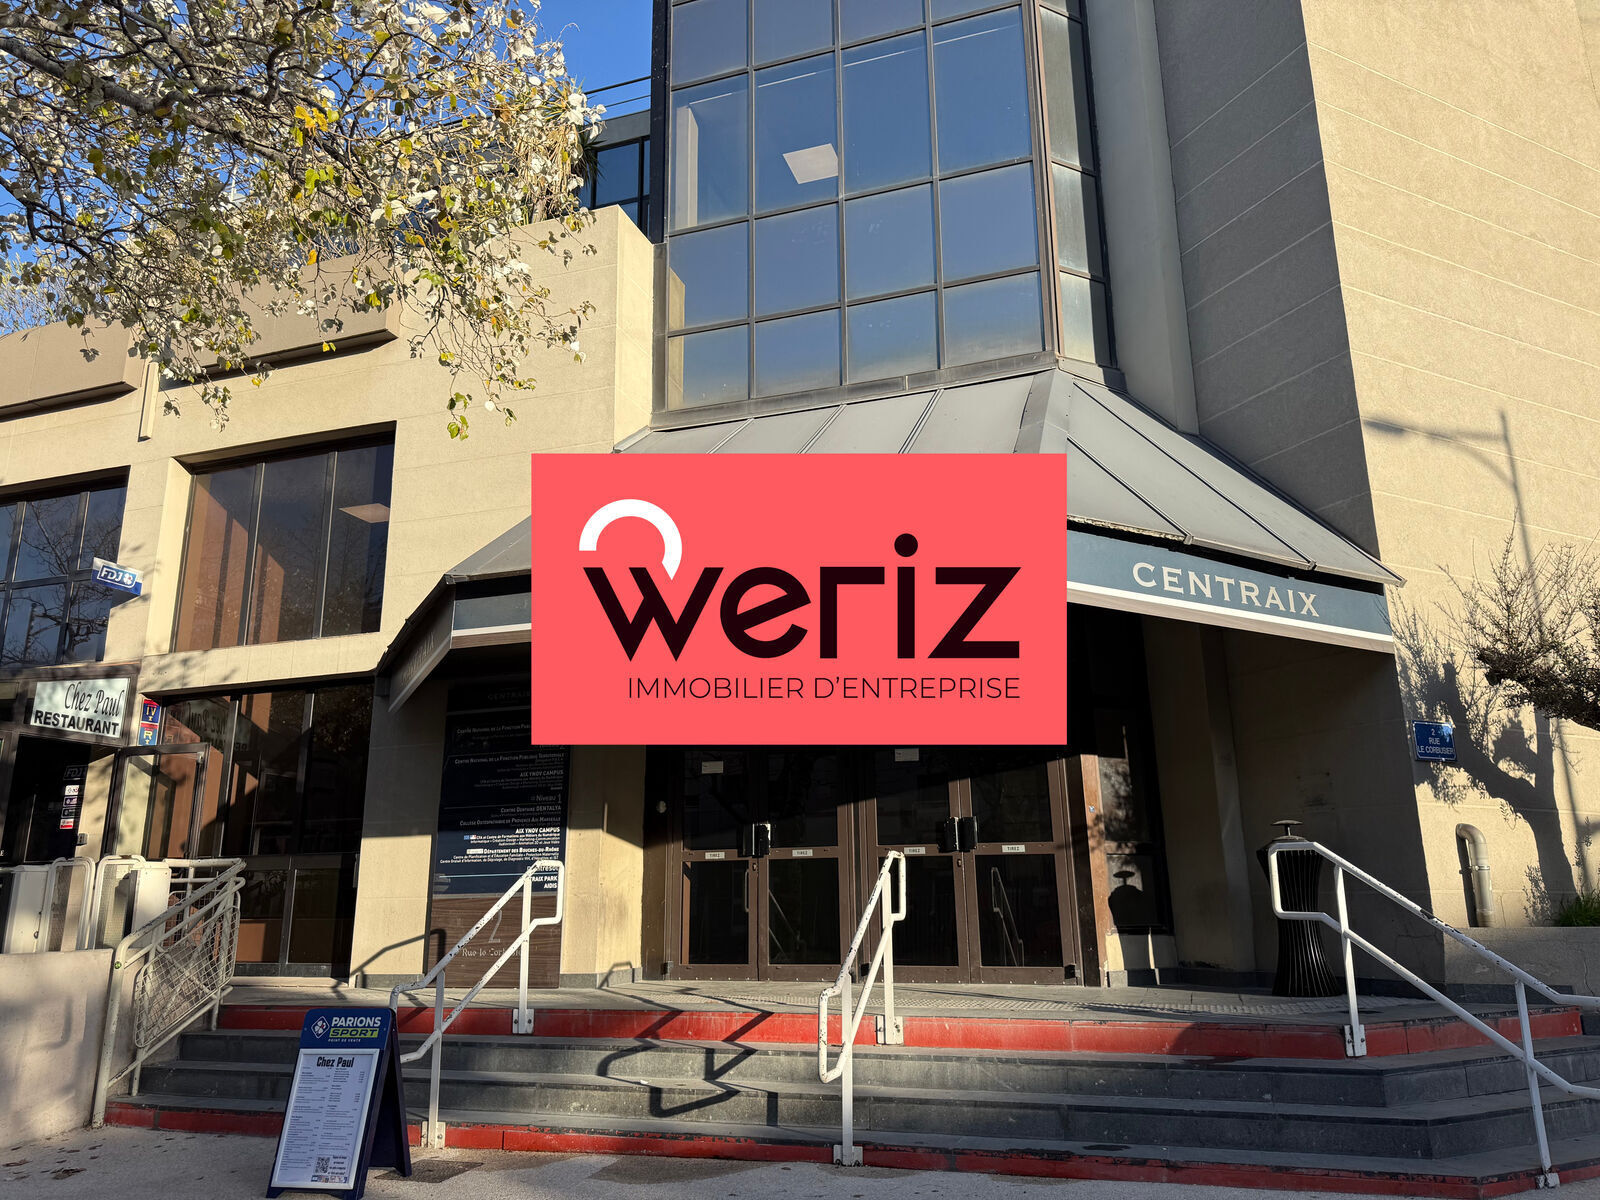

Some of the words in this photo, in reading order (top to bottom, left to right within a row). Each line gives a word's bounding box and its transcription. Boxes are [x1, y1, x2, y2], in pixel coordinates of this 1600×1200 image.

[101, 567, 123, 581] FDJ
[1132, 561, 1320, 617] CENTRAIX
[65, 681, 92, 712] Chez
[94, 690, 125, 717] Paul
[34, 710, 119, 736] RESTAURANT
[1431, 728, 1436, 736] 2
[1428, 737, 1440, 745] RUE
[1416, 745, 1425, 753] LE
[462, 948, 477, 957] Rue
[479, 948, 487, 956] le
[331, 1016, 382, 1027] PARIONS
[330, 1028, 378, 1037] SPORT
[316, 1056, 335, 1067] Chez
[336, 1056, 355, 1068] Paul
